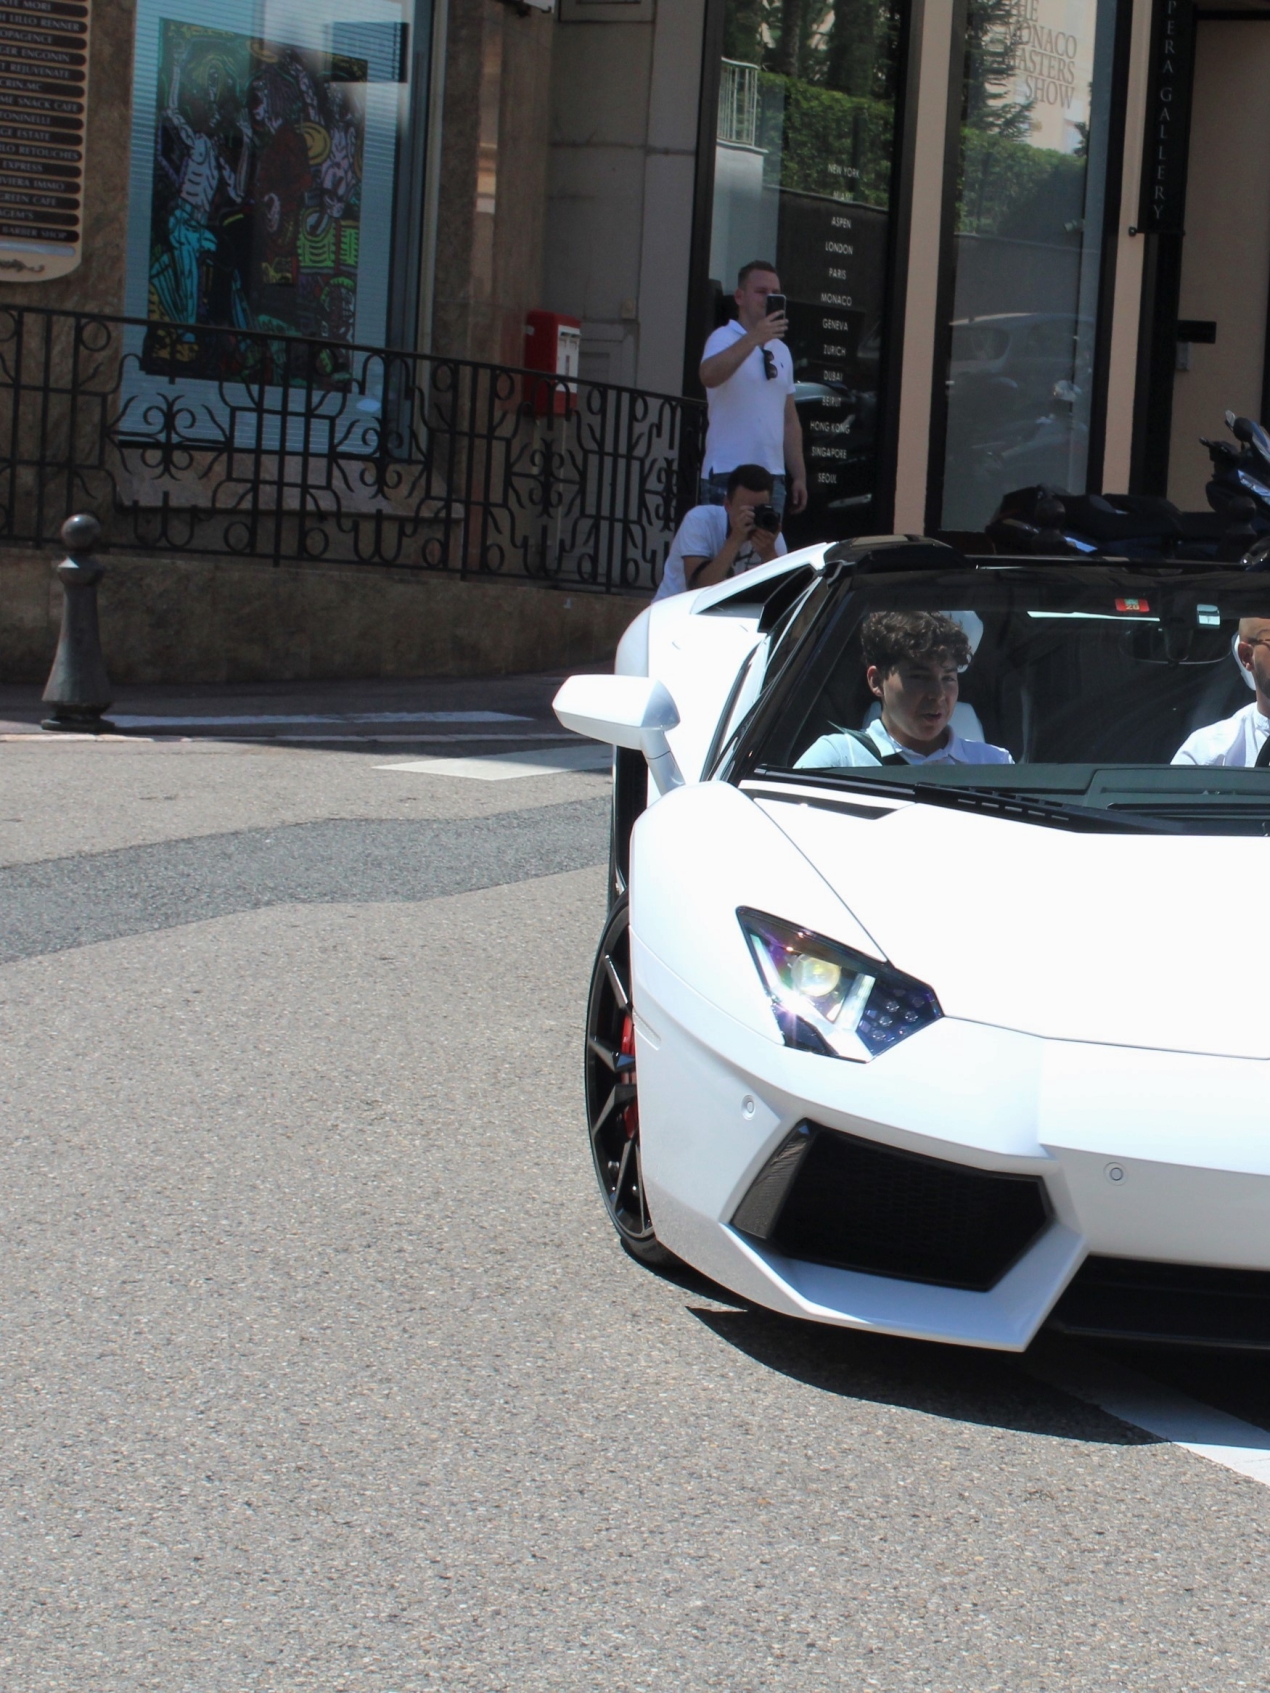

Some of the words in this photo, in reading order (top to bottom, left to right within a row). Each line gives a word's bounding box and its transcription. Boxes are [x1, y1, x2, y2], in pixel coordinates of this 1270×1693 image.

[23, 1, 51, 11] MORI
[40, 18, 80, 32] RENNER
[21, 48, 70, 62] ENGONIN
[10, 63, 70, 79] REJUVENATE
[1025, 75, 1075, 110] SHOW
[18, 97, 51, 109] SNACK
[54, 101, 79, 113] CAFE
[17, 129, 51, 142] ESTATE
[19, 146, 79, 160] RETOUCHES
[1153, 87, 1173, 220] GALLERY
[2, 160, 43, 173] EXPRESS
[828, 163, 843, 175] NEW
[844, 166, 860, 179] YORK
[33, 195, 58, 207] CAFE
[831, 216, 852, 229] ASPEN
[2, 225, 38, 238] BARBER
[41, 229, 67, 240] SHOP
[825, 241, 854, 255] LONDON
[828, 267, 847, 280] PARIS
[821, 293, 853, 307] MONACO
[822, 318, 849, 332] GENEVA
[823, 344, 846, 357] ZURICH
[823, 370, 843, 382] DUBAI
[822, 395, 842, 408] BEIRUT
[810, 421, 830, 433] HONG
[831, 423, 850, 435] KONG
[811, 446, 847, 459] SINGAPORE
[818, 472, 837, 485] SEOUL
